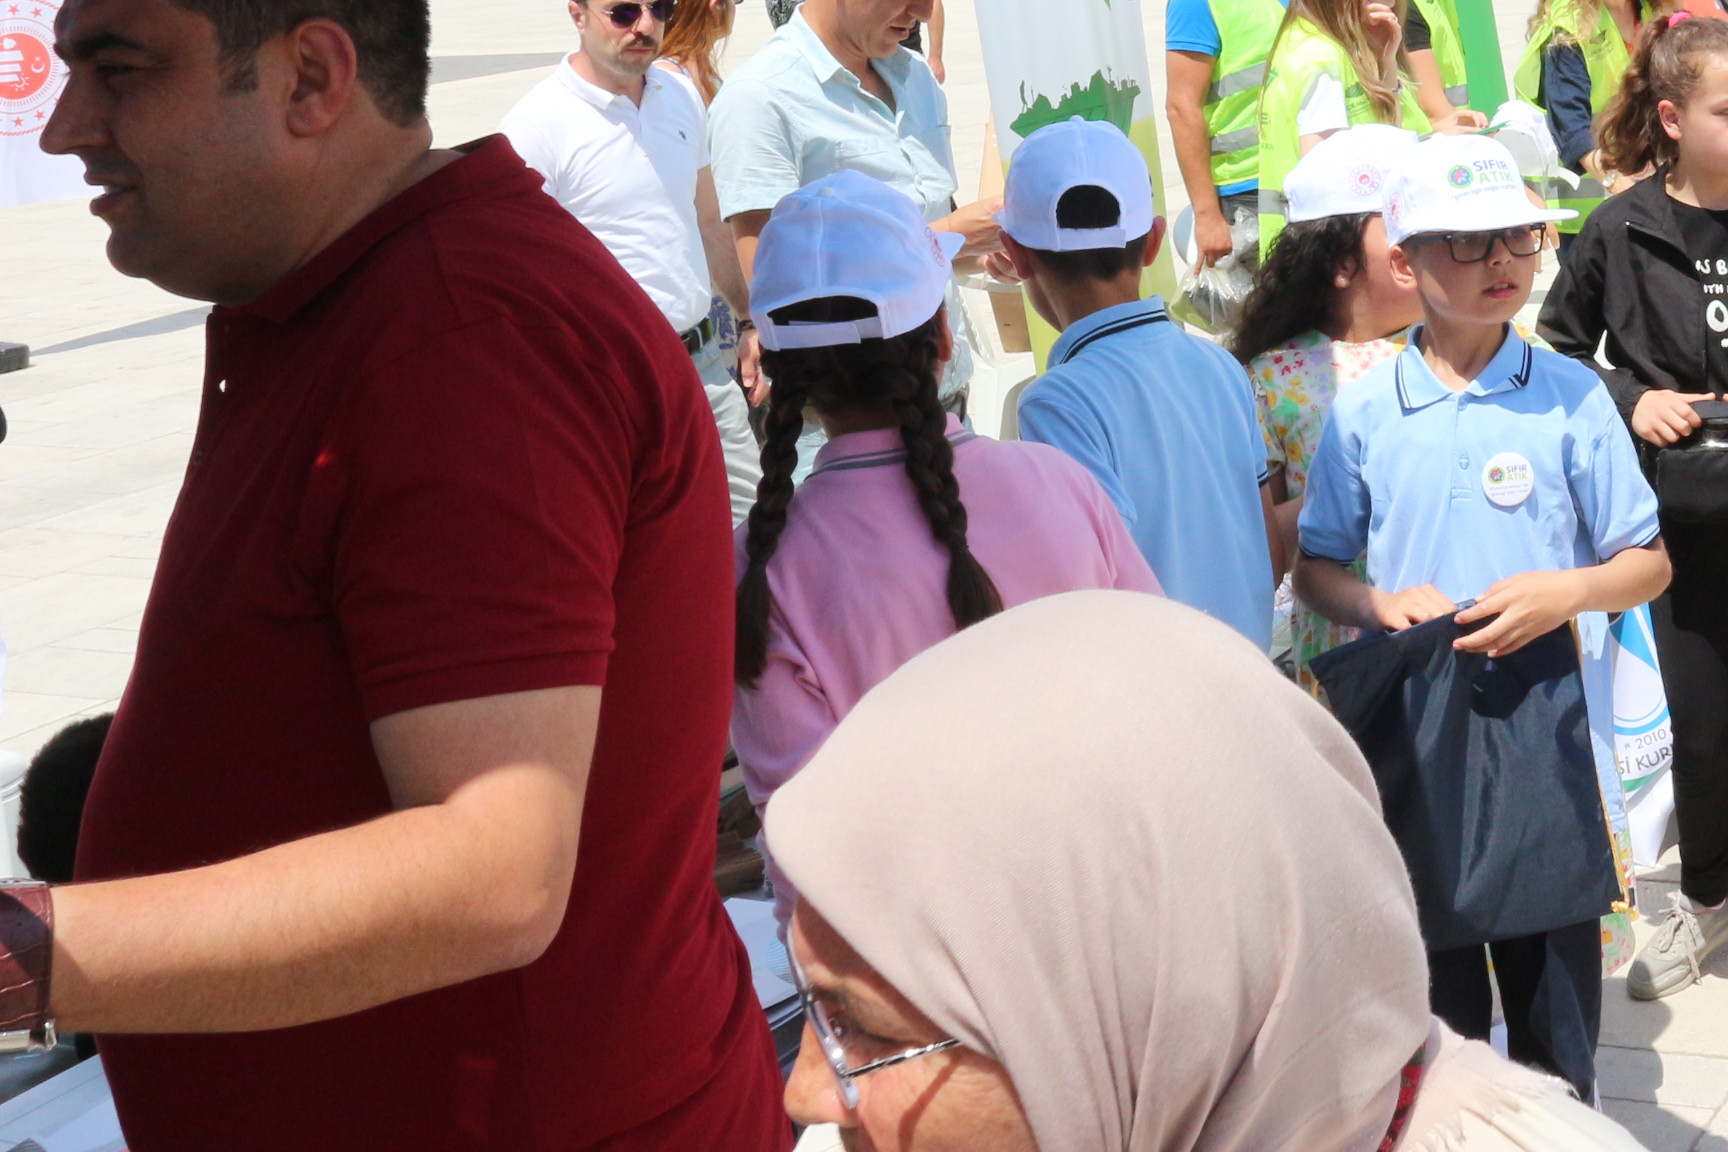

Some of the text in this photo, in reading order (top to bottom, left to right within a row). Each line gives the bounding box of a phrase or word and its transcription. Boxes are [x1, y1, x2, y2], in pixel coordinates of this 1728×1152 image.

[1473, 159, 1509, 172] SIFIR
[1479, 171, 1514, 185] ATIK
[1635, 728, 1667, 750] 2010
